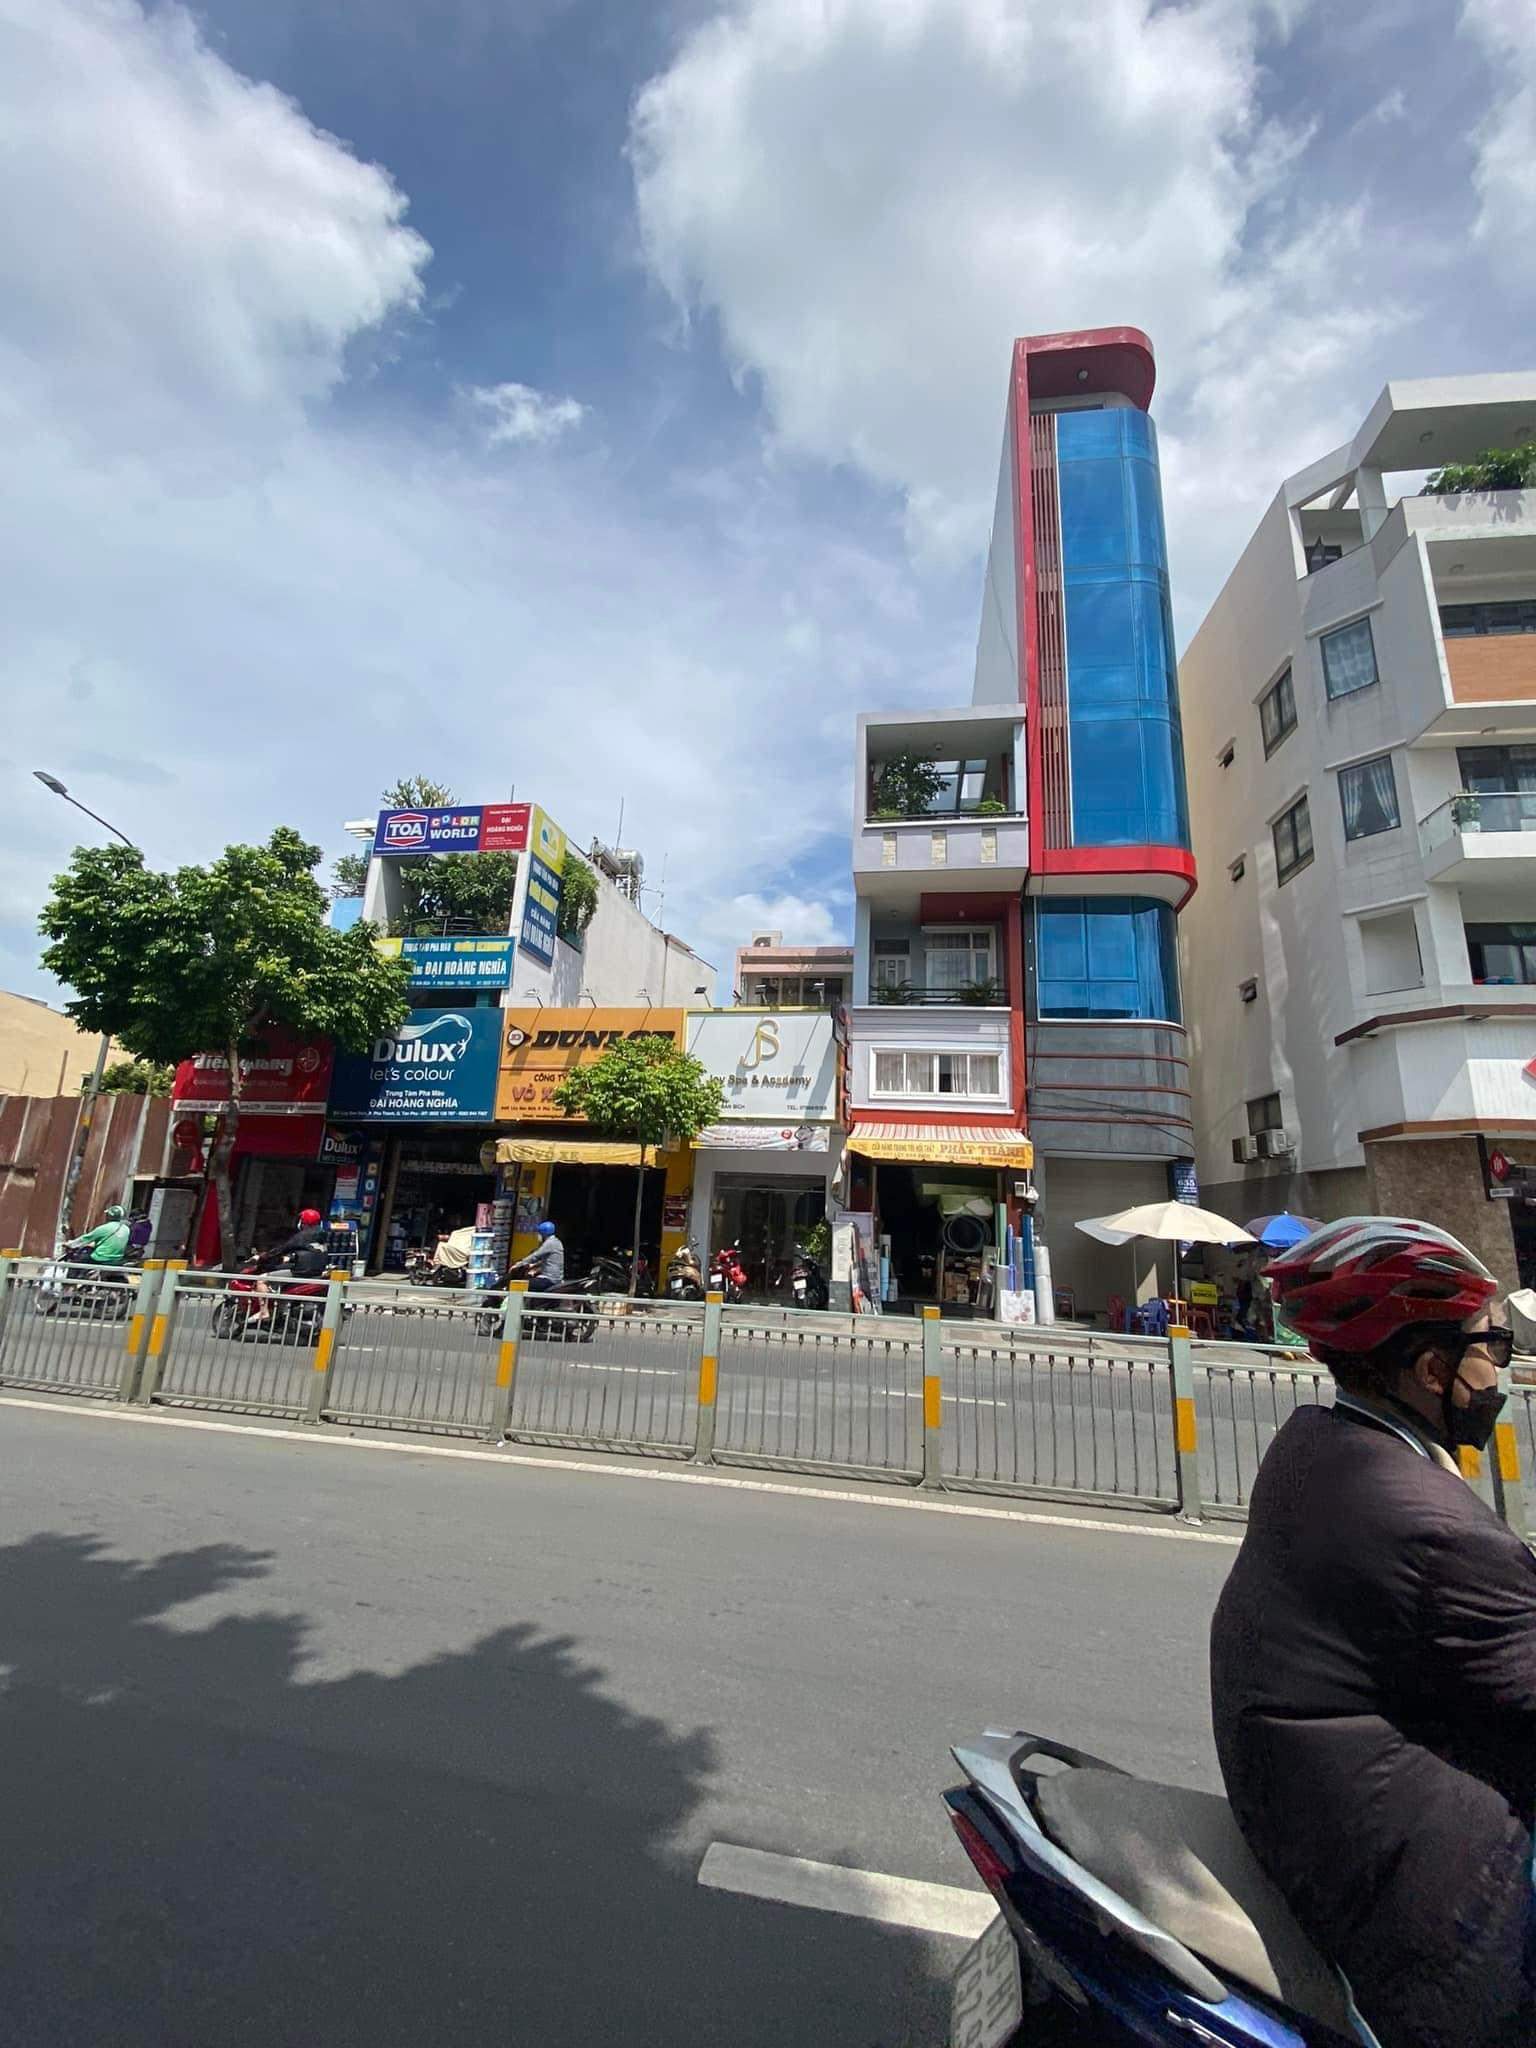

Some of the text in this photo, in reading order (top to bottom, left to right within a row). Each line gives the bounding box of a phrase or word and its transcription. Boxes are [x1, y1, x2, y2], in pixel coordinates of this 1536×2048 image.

[390, 824, 422, 836] TOA
[430, 828, 478, 839] WORLD
[424, 961, 442, 978] ĐẠI
[444, 958, 475, 975] HOÀNG
[478, 958, 506, 975] NGHĨA
[373, 1036, 457, 1063] Dulux
[403, 1068, 455, 1081] colour
[534, 1073, 554, 1083] CÔNG
[727, 1075, 748, 1087] Spa
[389, 1098, 424, 1108] HOÀNG
